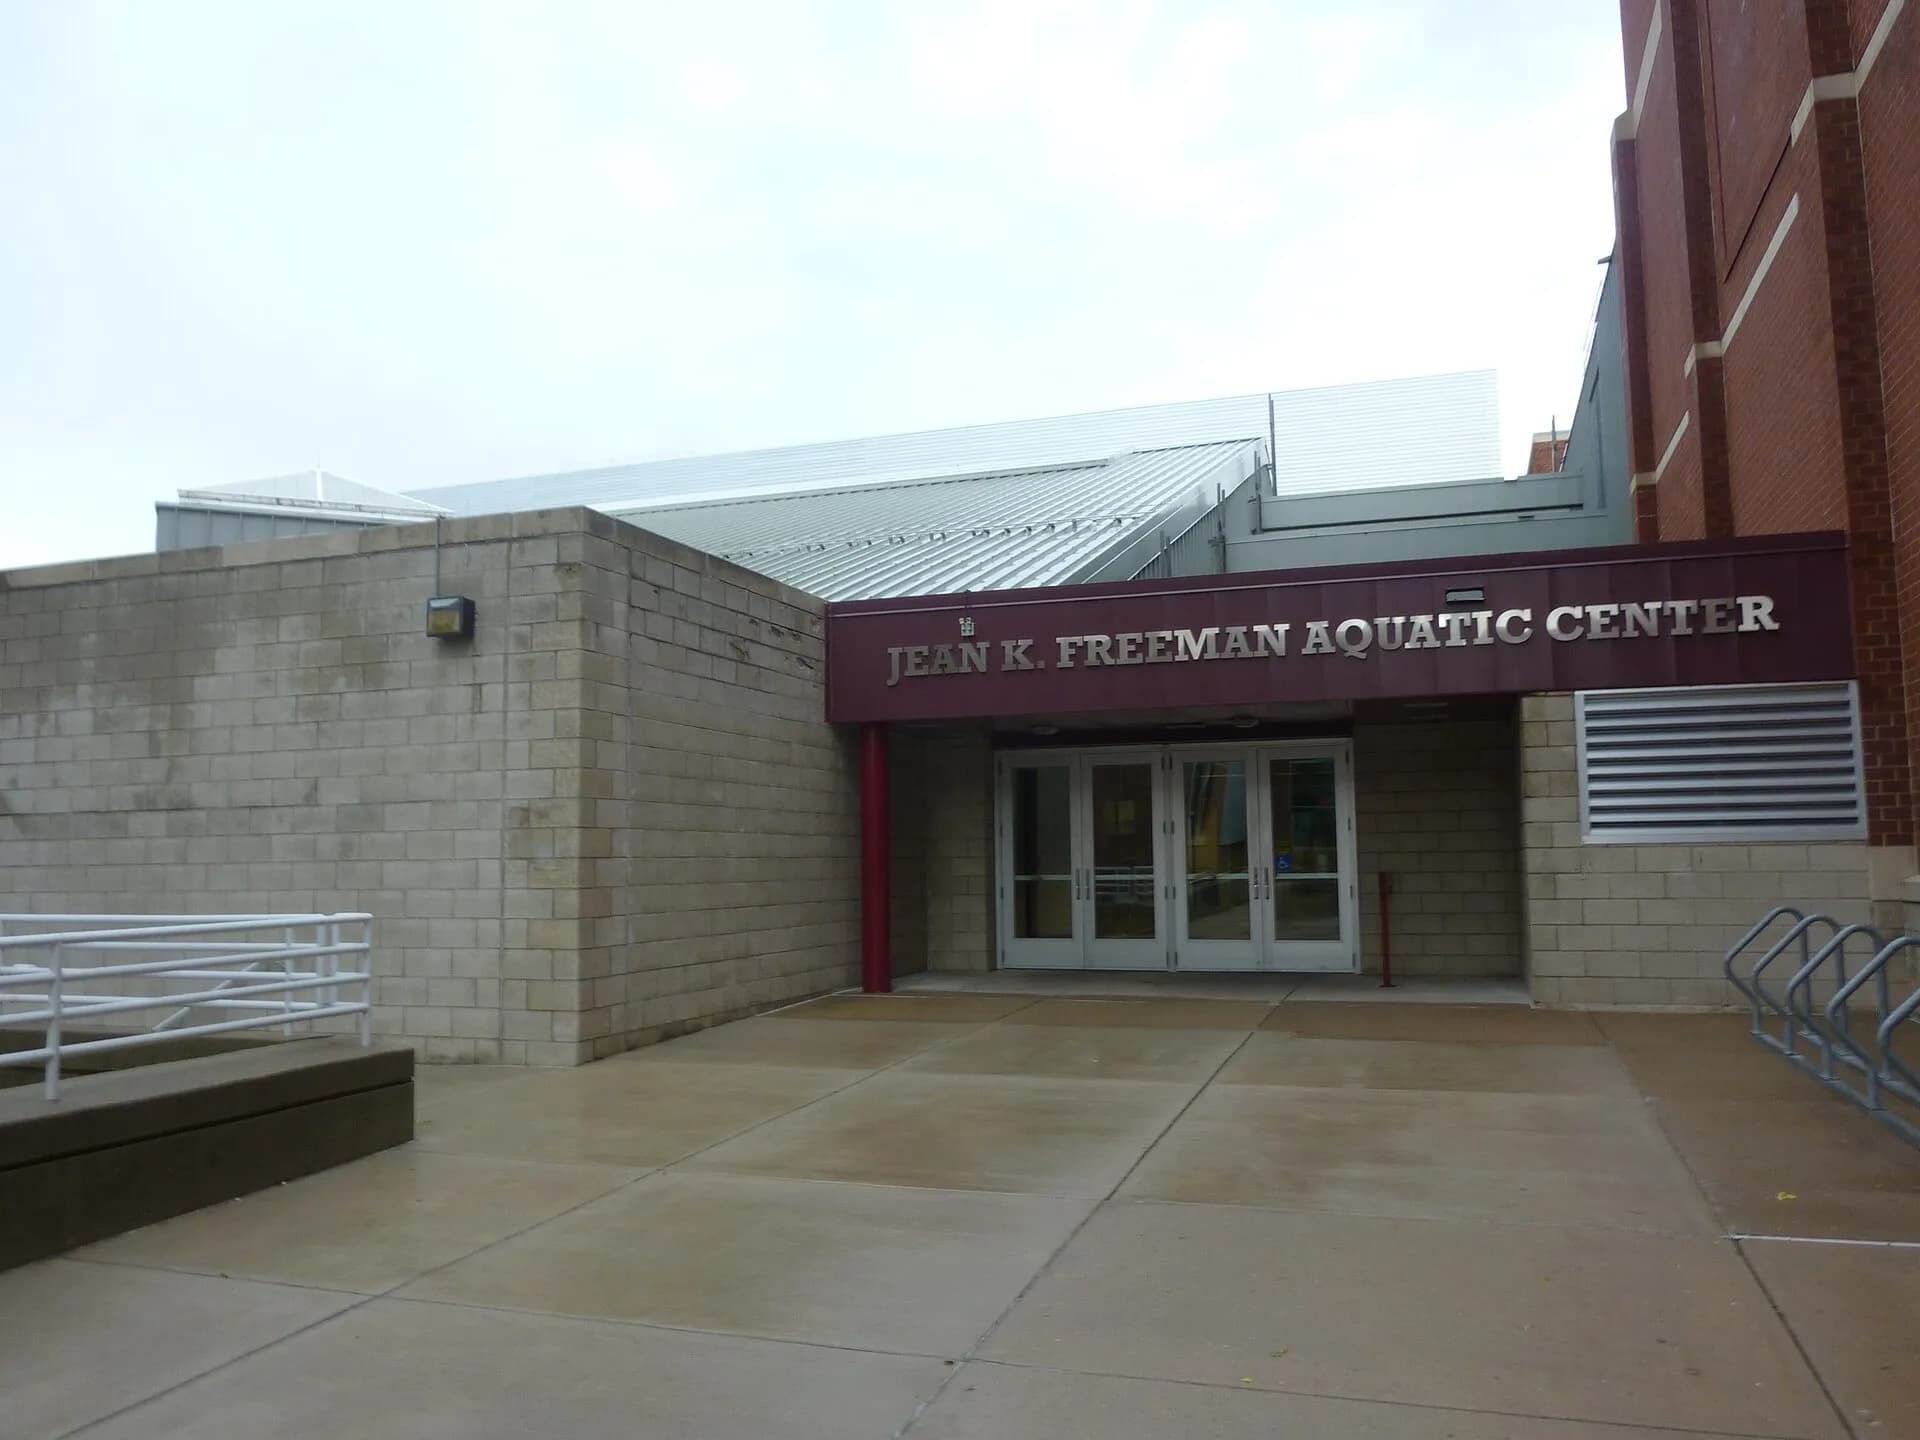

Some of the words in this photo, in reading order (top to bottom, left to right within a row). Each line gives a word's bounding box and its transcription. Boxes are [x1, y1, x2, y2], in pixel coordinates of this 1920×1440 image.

[887, 641, 990, 686] JEAN
[1000, 639, 1045, 671] K.
[1056, 623, 1289, 668] FREEMAN
[1301, 608, 1533, 659] AQUATIC
[1546, 595, 1780, 641] CENTER
